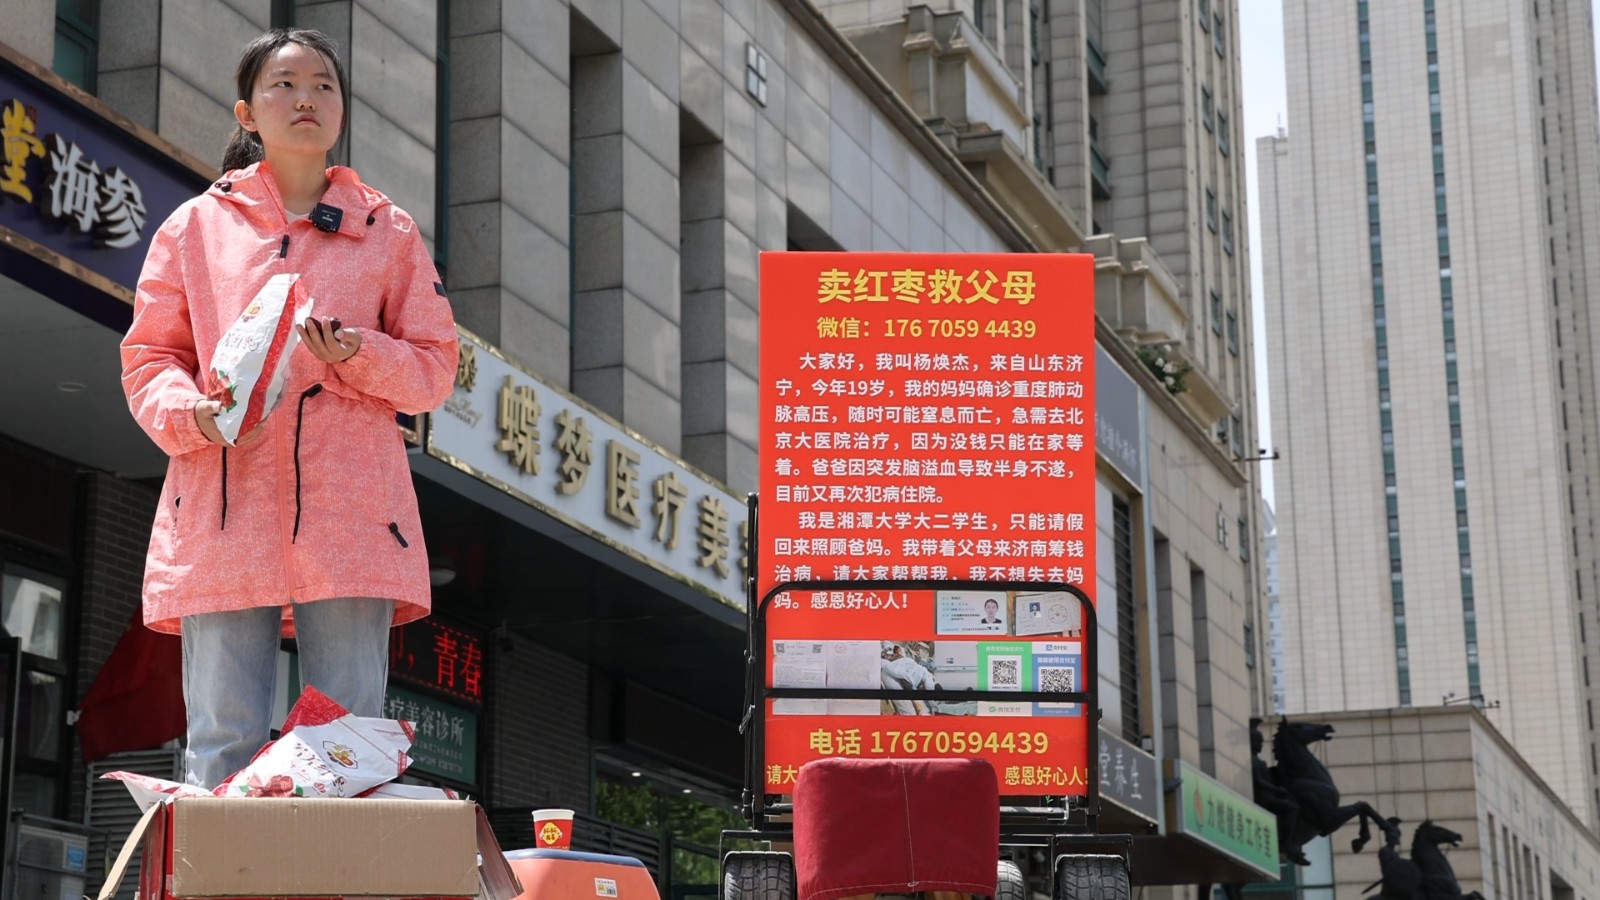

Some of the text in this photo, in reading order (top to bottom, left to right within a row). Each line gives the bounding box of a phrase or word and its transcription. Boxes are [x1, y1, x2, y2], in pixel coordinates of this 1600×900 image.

[818, 268, 1036, 305] 卖红枣救父母
[928, 318, 979, 338] 7059
[985, 318, 1036, 338] 4439
[799, 352, 1083, 373] 大家好，我叫杨焕杰，来自山东济
[775, 379, 1083, 399] 宁，今年19岁，我的妈妈确诊重度肺动
[774, 405, 1083, 425] 脉高压，随时可能窒息而亡，急需去北
[775, 432, 1083, 452] 京大医院治疗，因为没钱只能在家等
[774, 458, 1075, 479] 着。爸爸因突发脑溢血导致半身不遂，
[497, 375, 750, 591] 蝶梦医疗美
[776, 484, 946, 504] 目前又再次犯病住院。
[798, 512, 1084, 532] 我是湘潭大学大二学生，只能请假
[774, 538, 1084, 558] 回来照顾爸妈。我带着父母来济南筹钱
[384, 694, 465, 746] 疗美容诊所
[809, 728, 1049, 755] 电话 17670594439
[766, 764, 803, 785] 请大
